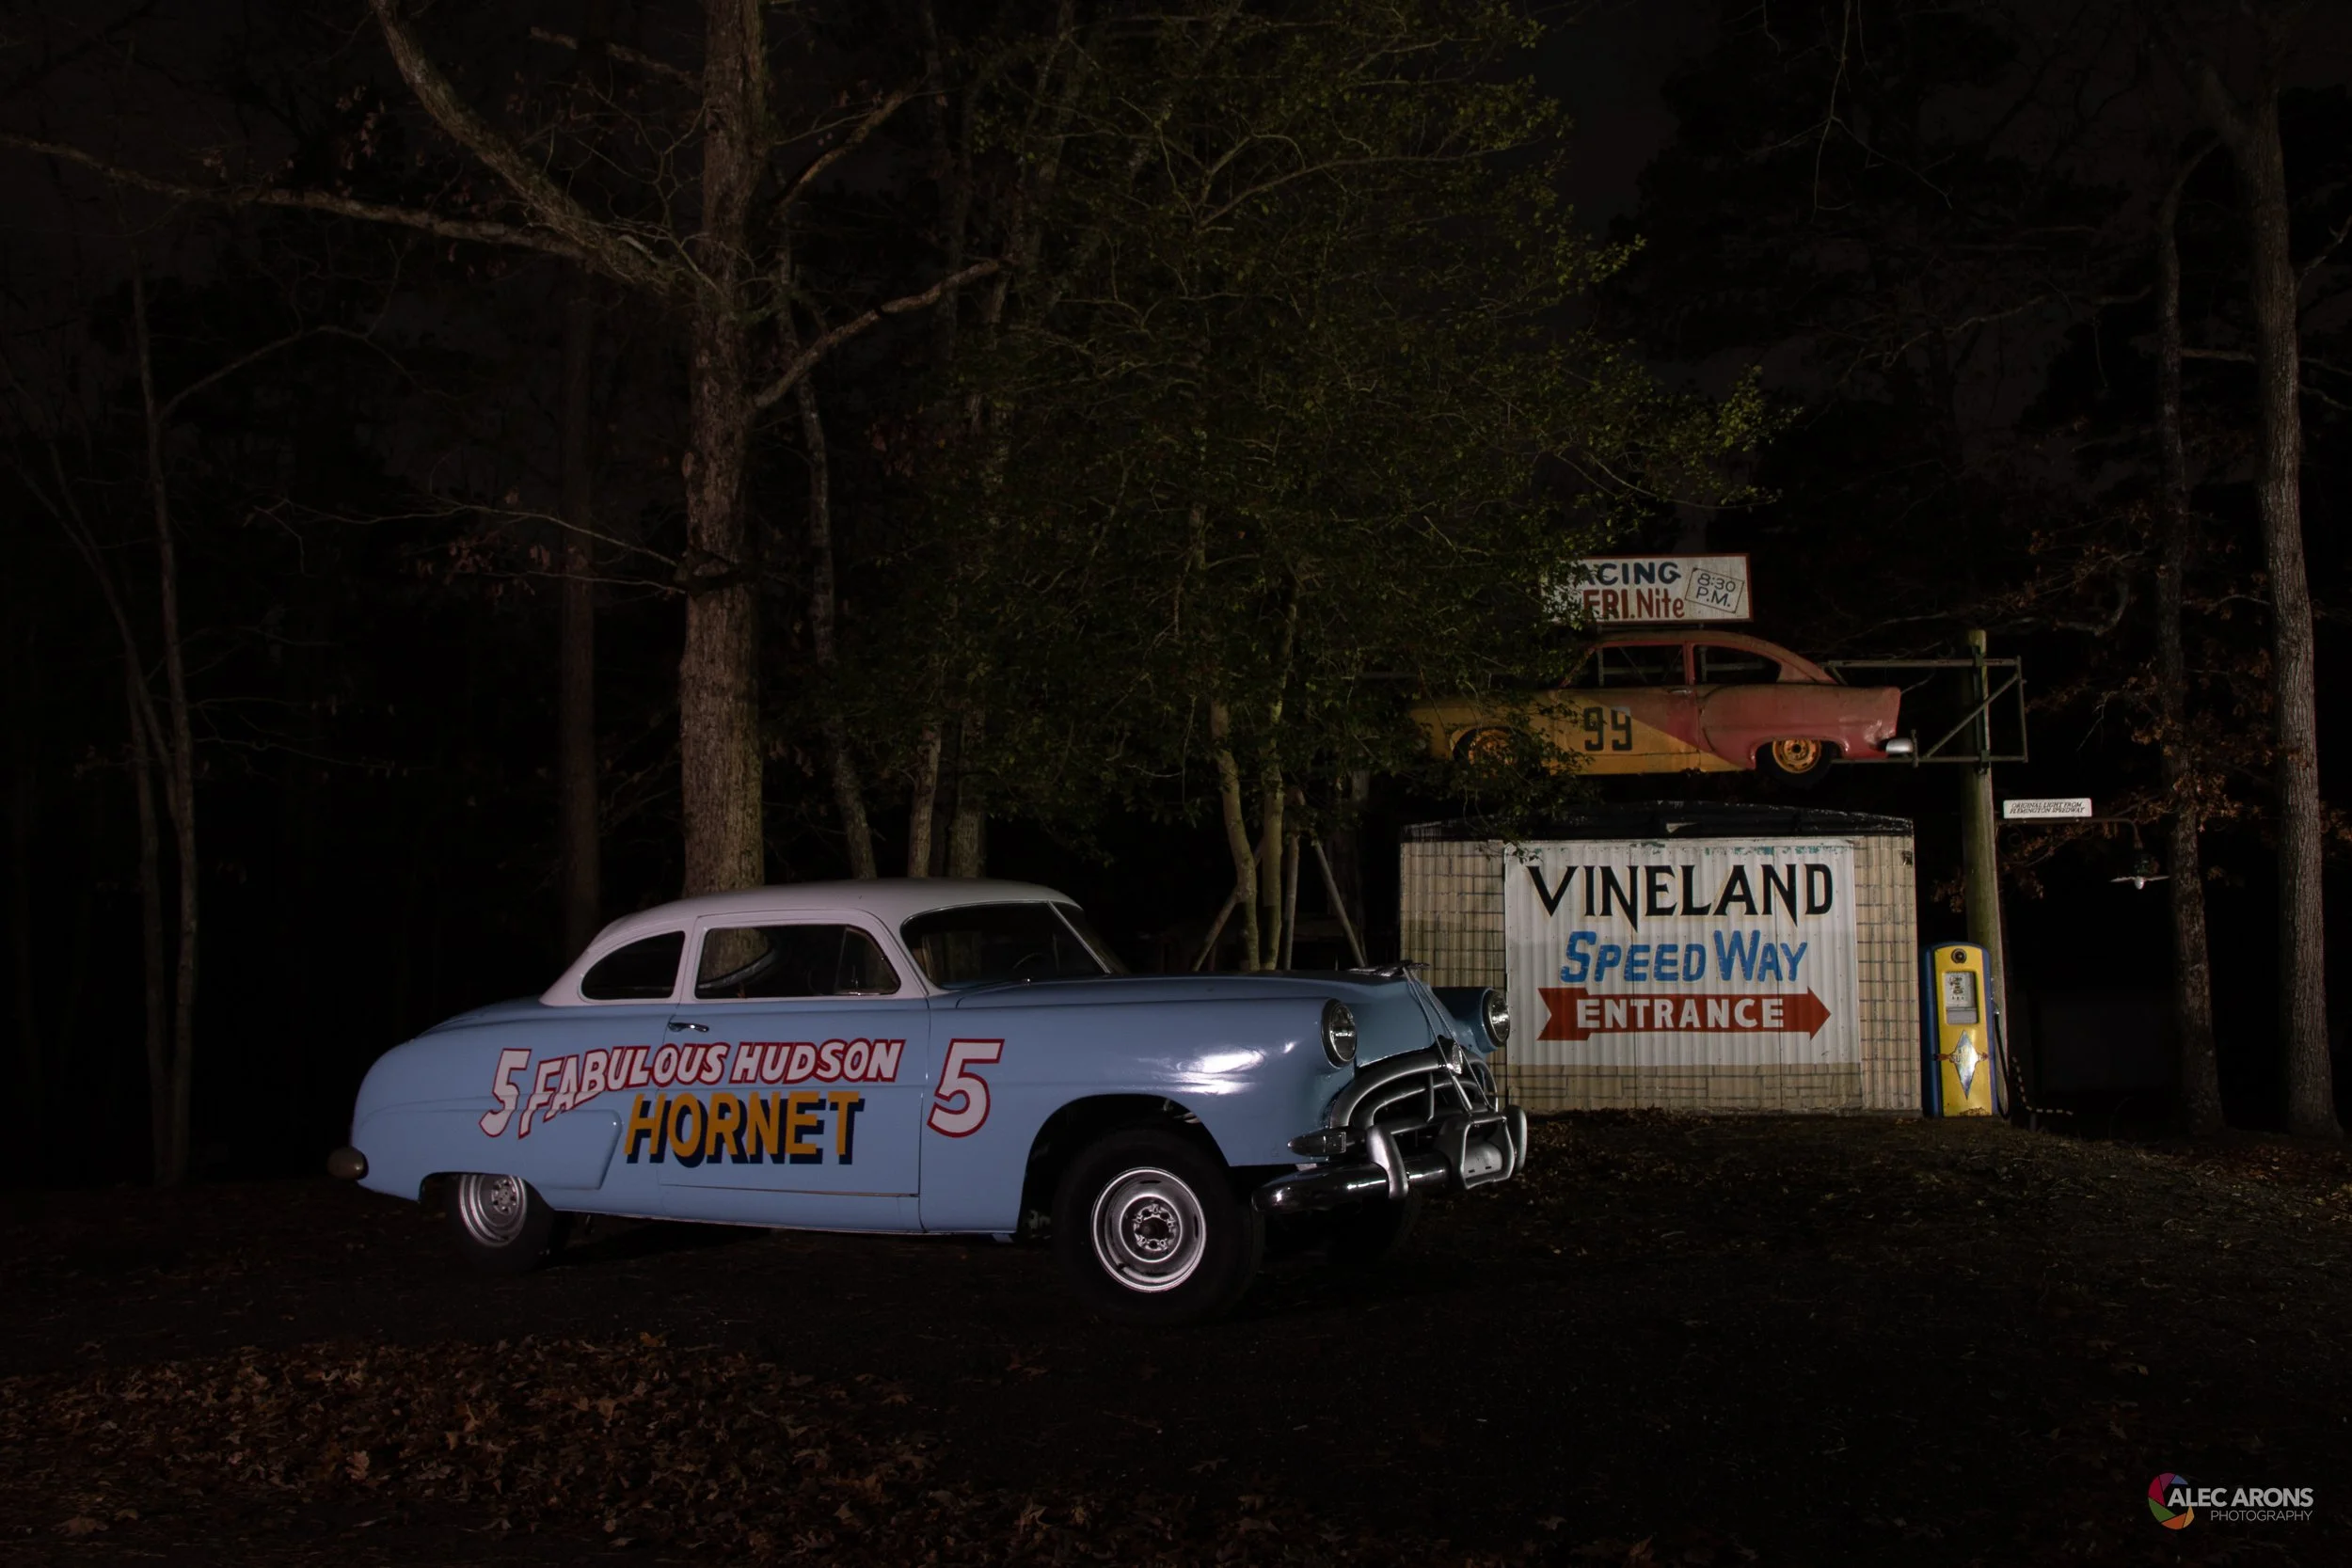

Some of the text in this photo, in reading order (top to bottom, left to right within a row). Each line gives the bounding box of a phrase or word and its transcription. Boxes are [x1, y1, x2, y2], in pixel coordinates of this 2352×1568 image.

[1569, 562, 1681, 585] ACING
[1697, 572, 1736, 593] 8:30
[1696, 586, 1731, 608] P.M.
[1584, 706, 1632, 751] 99
[1527, 863, 1834, 932] VINELAND
[1576, 997, 1785, 1030] ENTRANCE
[478, 1037, 907, 1140] 5 FABULOUS HUDSON
[927, 1038, 1006, 1138] 5
[624, 1090, 866, 1168] HORNET
